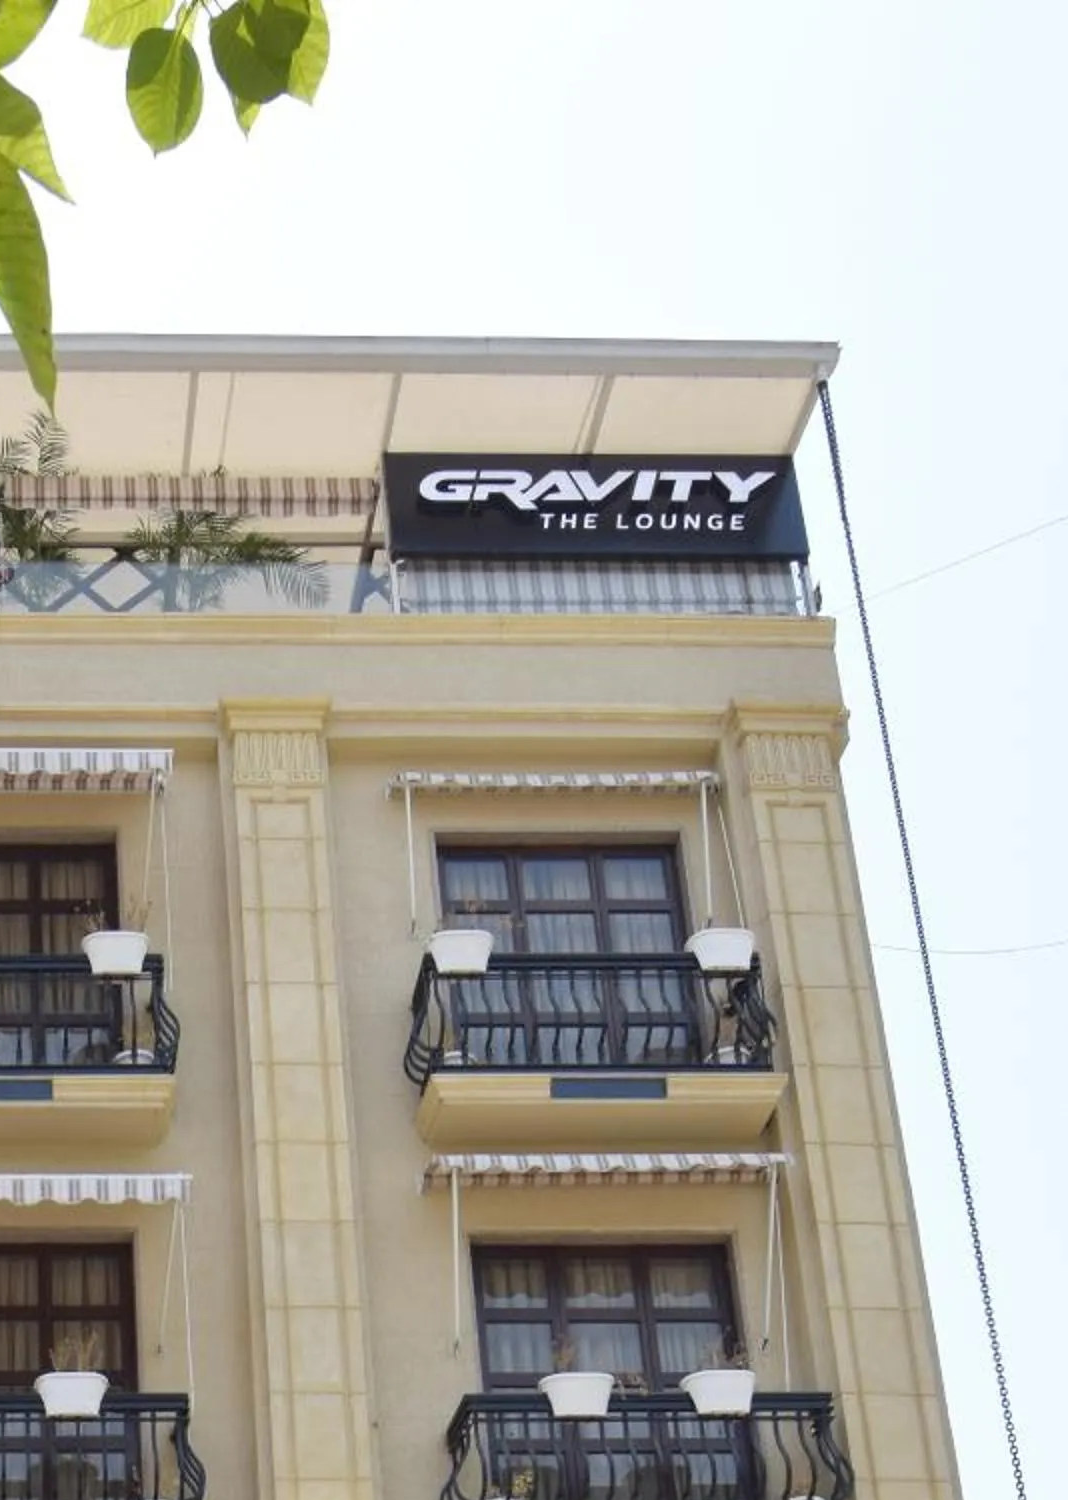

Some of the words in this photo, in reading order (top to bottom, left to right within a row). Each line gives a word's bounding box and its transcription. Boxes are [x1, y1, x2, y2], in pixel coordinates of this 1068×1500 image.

[419, 469, 776, 510] GRAVITY
[540, 513, 598, 529] THE
[616, 513, 746, 531] LOUNGE
